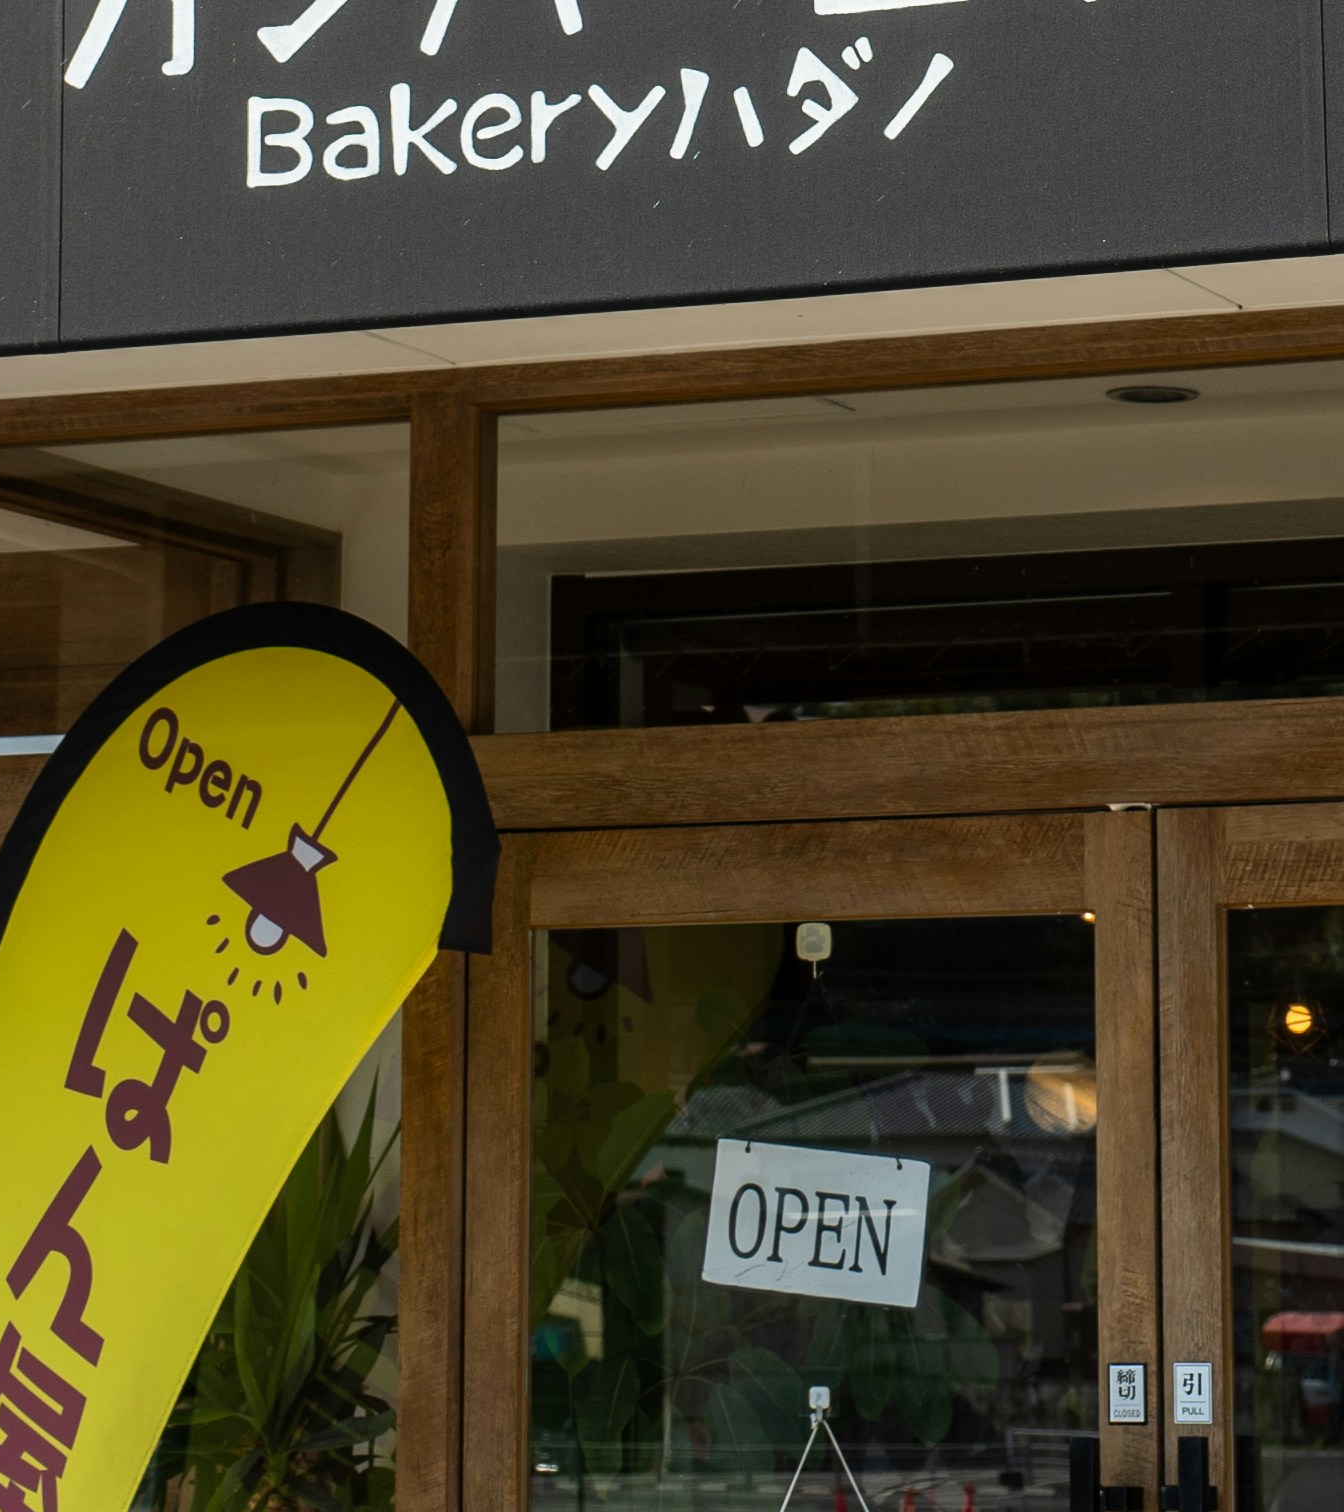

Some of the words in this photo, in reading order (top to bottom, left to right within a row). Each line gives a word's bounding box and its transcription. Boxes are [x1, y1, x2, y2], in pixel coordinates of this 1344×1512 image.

[136, 703, 264, 832] Open
[728, 1182, 897, 1276] OPEN
[1117, 1369, 1137, 1401] 締切
[1183, 1372, 1202, 1396] 引
[1114, 1409, 1141, 1418] CLOSED
[1182, 1407, 1204, 1415] PULL
